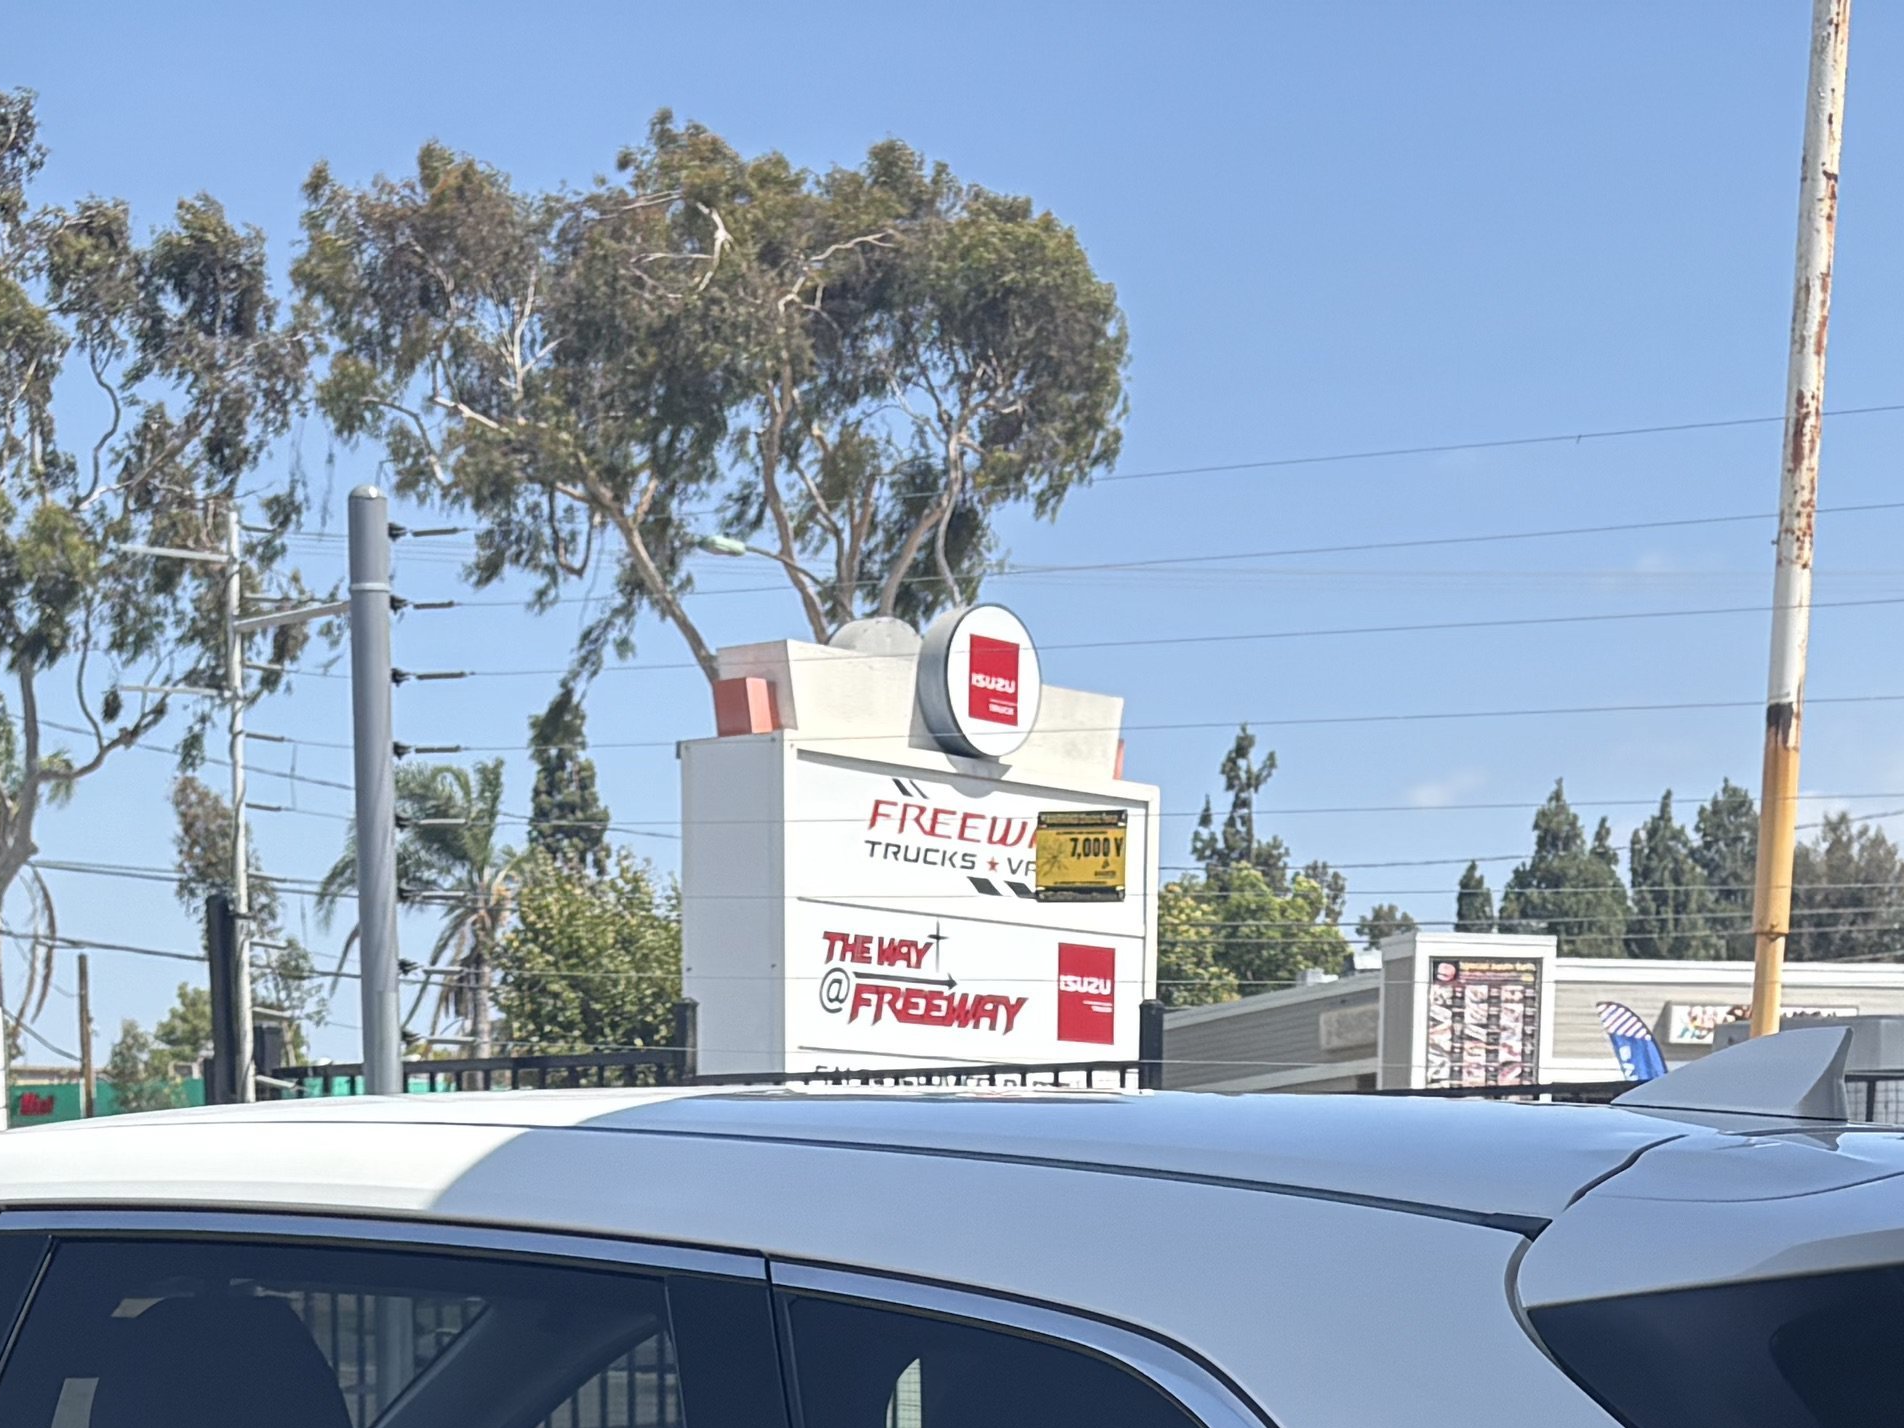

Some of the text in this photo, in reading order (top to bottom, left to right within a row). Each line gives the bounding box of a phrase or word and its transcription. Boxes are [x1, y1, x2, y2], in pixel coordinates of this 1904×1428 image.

[971, 672, 1016, 694] ISUZU
[868, 799, 1037, 849] FREEW
[865, 839, 977, 870] TRUCKS
[1069, 836, 1110, 860] 7,000
[822, 931, 934, 969] THE WAY
[1059, 974, 1112, 995] ISUZU
[819, 967, 1030, 1036] @FREEWAY
